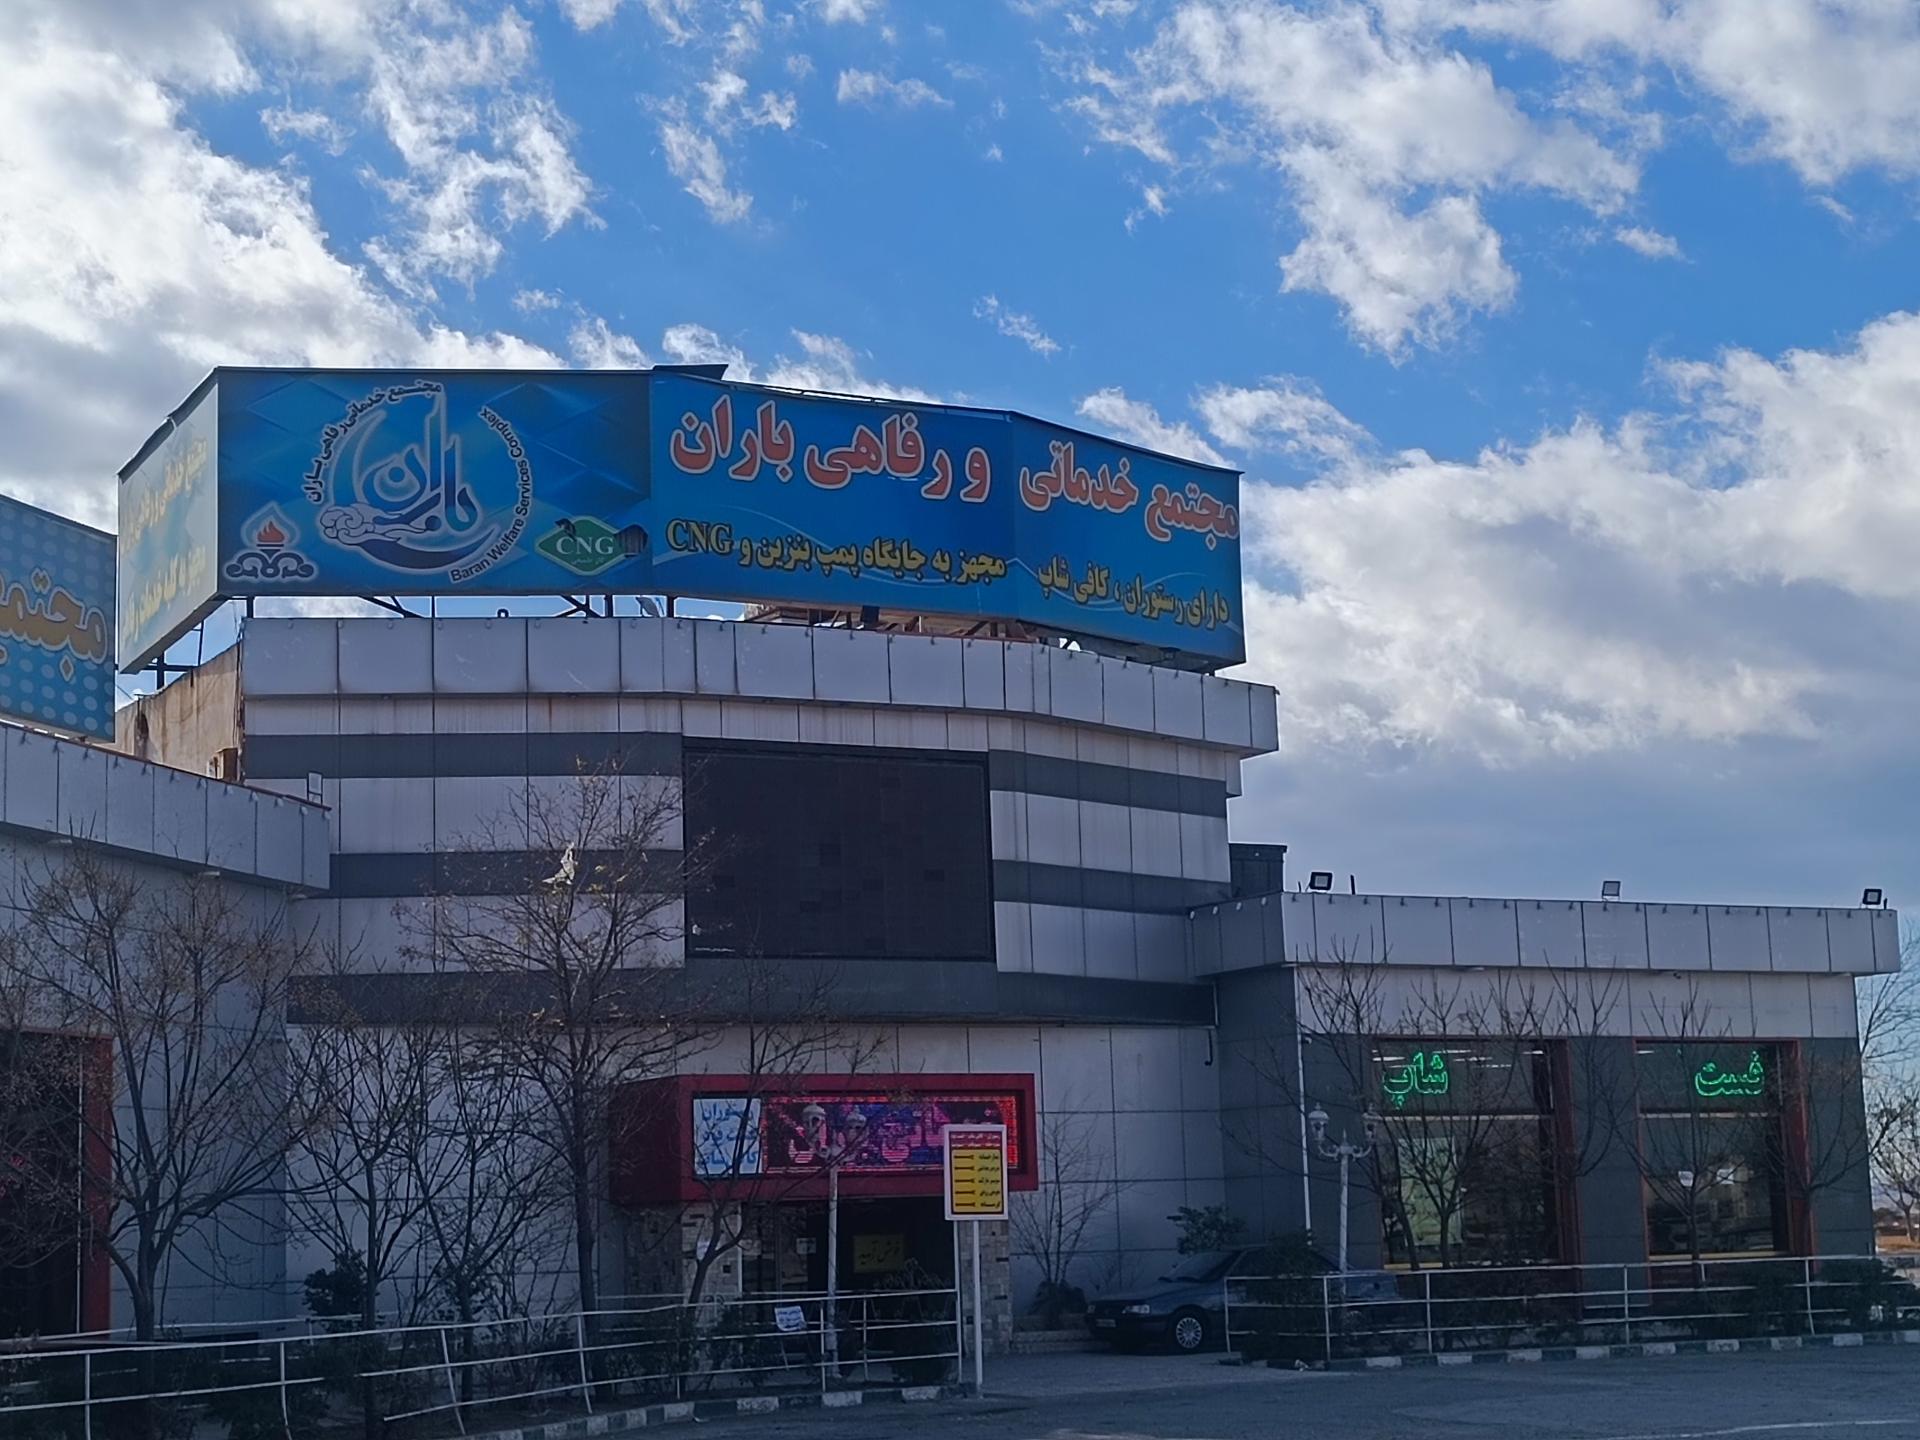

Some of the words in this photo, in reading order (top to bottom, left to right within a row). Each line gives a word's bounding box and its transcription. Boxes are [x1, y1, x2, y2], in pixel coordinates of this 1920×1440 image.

[346, 388, 386, 428] خدماتی
[388, 380, 442, 403] مجتمع
[481, 406, 523, 458] Complex
[670, 395, 795, 482] باران
[804, 412, 953, 500] رفاهی
[959, 446, 991, 502] و
[1019, 439, 1139, 513] خدماتی
[304, 459, 323, 503] باران
[515, 458, 532, 517] Services
[667, 519, 734, 555] CNG
[1145, 482, 1240, 550] مجتمع
[487, 518, 526, 562] Welfare
[556, 536, 615, 556] CNG
[739, 540, 752, 566] و
[756, 534, 811, 571] بنزین
[816, 543, 860, 576] پمپ
[861, 537, 926, 581] جایگاه
[931, 543, 951, 577] به
[450, 558, 491, 583] Baran
[956, 553, 1006, 584] مجهز
[1039, 556, 1070, 597] شاپ
[1074, 561, 1109, 604] کافی
[0, 567, 107, 682] مجتم
[1186, 588, 1230, 630] دارای
[1382, 1051, 1448, 1110] شاپ
[1695, 1051, 1765, 1096] فست
